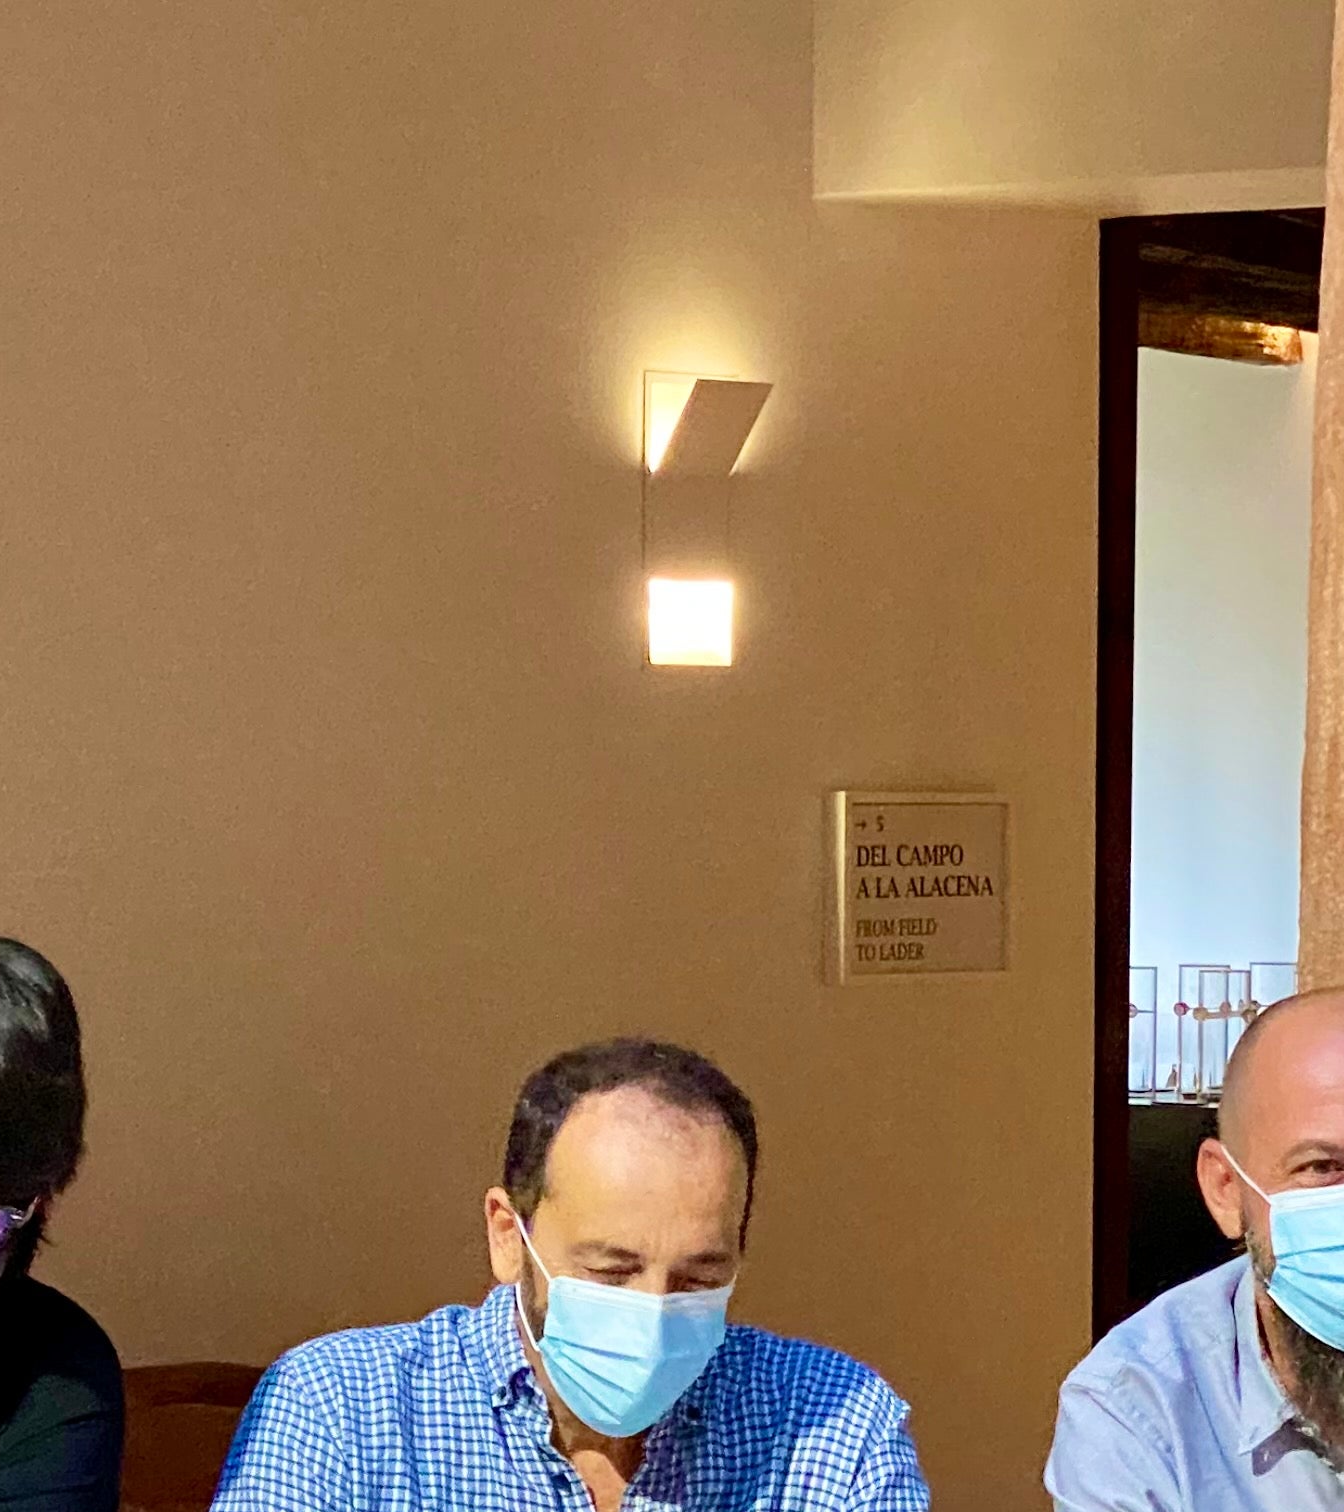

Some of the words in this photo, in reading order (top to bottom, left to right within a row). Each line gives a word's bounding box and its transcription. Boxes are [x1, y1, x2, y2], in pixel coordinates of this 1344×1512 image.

[856, 845, 891, 867] DEL
[896, 844, 964, 867] CAMPO
[856, 877, 870, 899] A
[876, 877, 900, 898] LA
[906, 875, 993, 898] ALACENA
[856, 920, 895, 937] FROM
[899, 918, 938, 936] FIELD
[856, 943, 876, 961] TO
[879, 942, 925, 961] LADER
